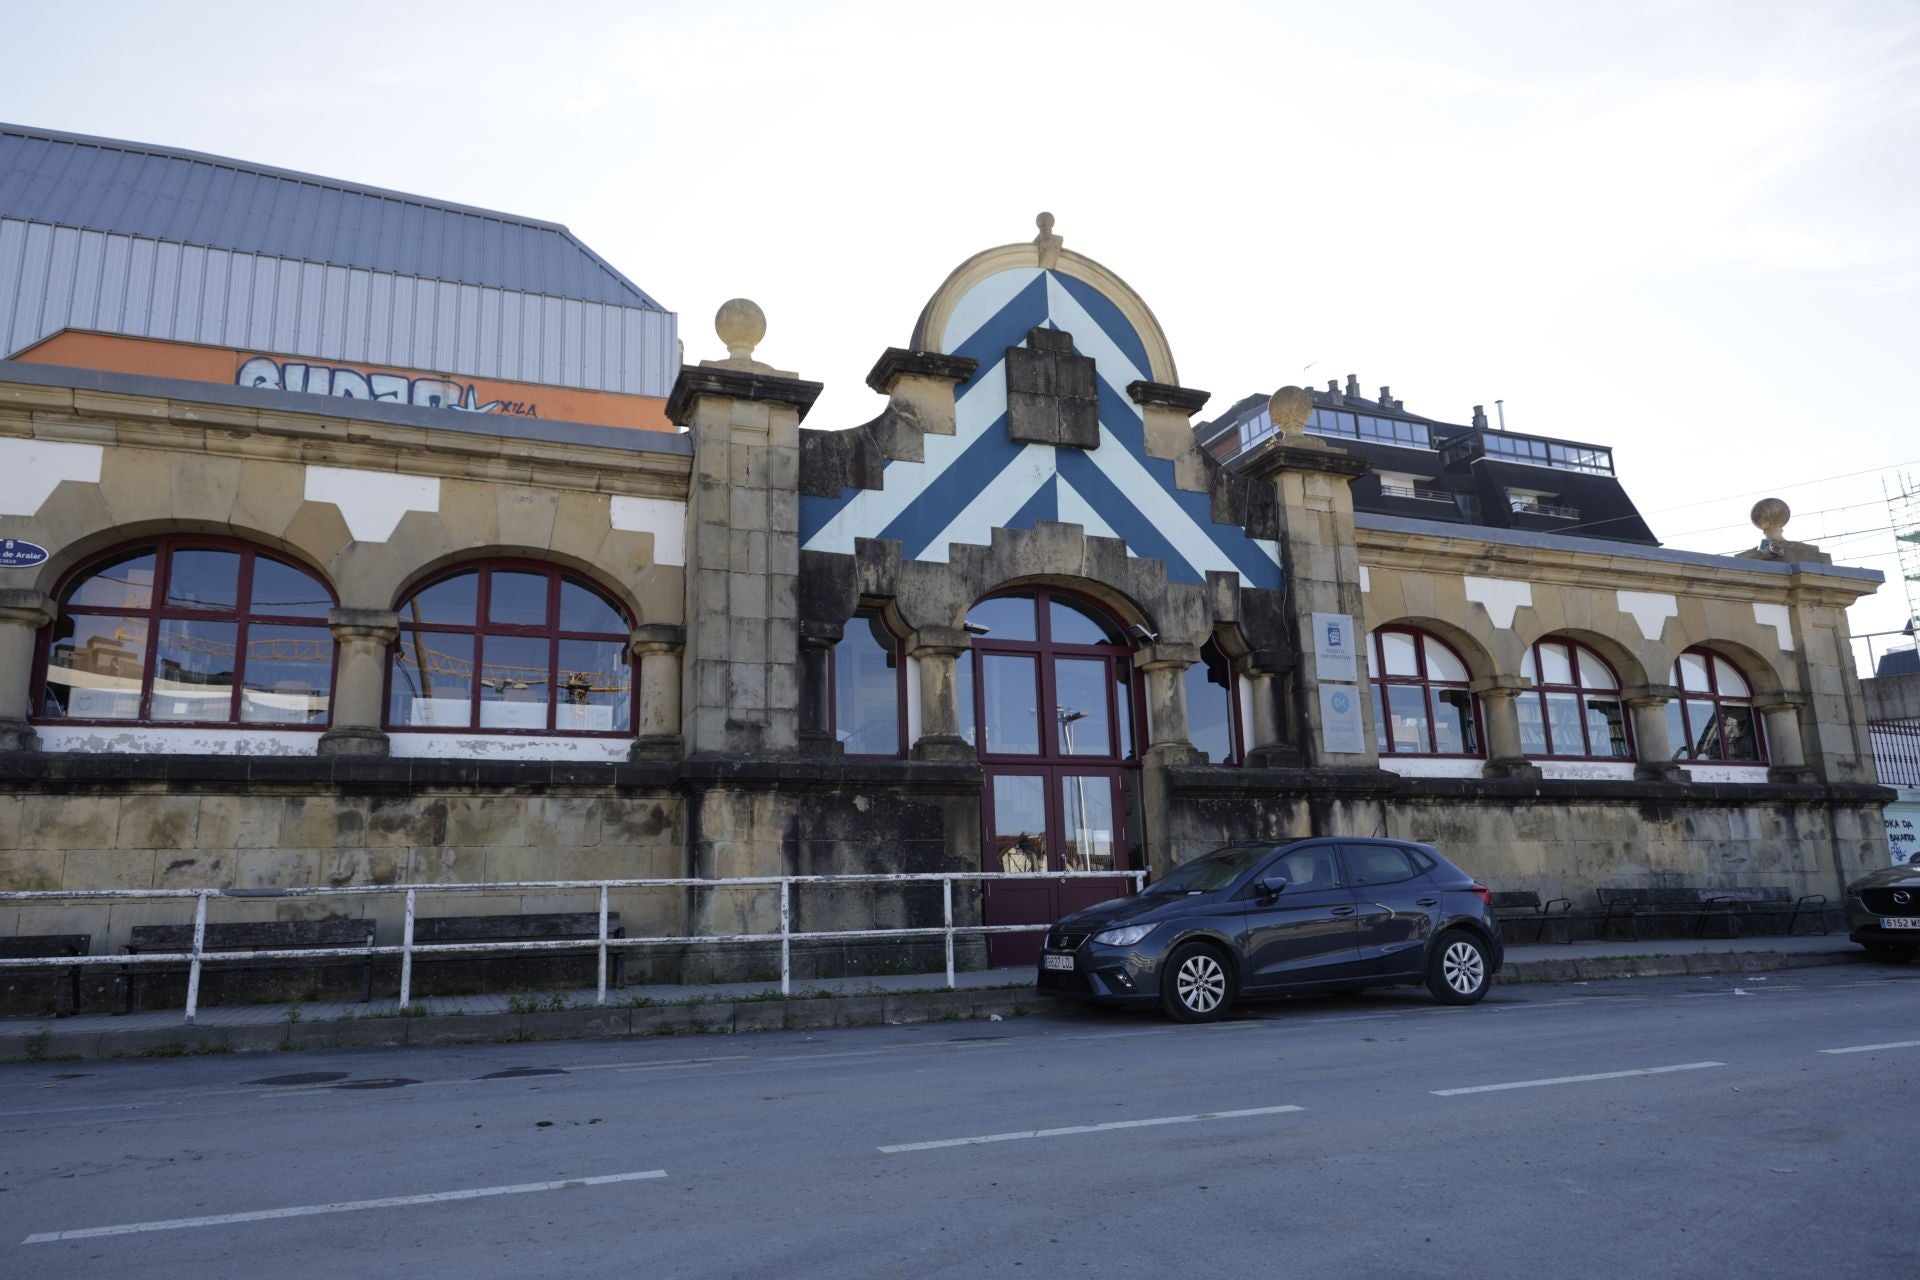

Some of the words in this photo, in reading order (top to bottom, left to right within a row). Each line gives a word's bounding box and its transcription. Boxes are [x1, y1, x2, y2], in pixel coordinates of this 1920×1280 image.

[2, 550, 14, 558] de
[15, 551, 42, 560] Aralar
[1886, 919, 1909, 928] 6152
